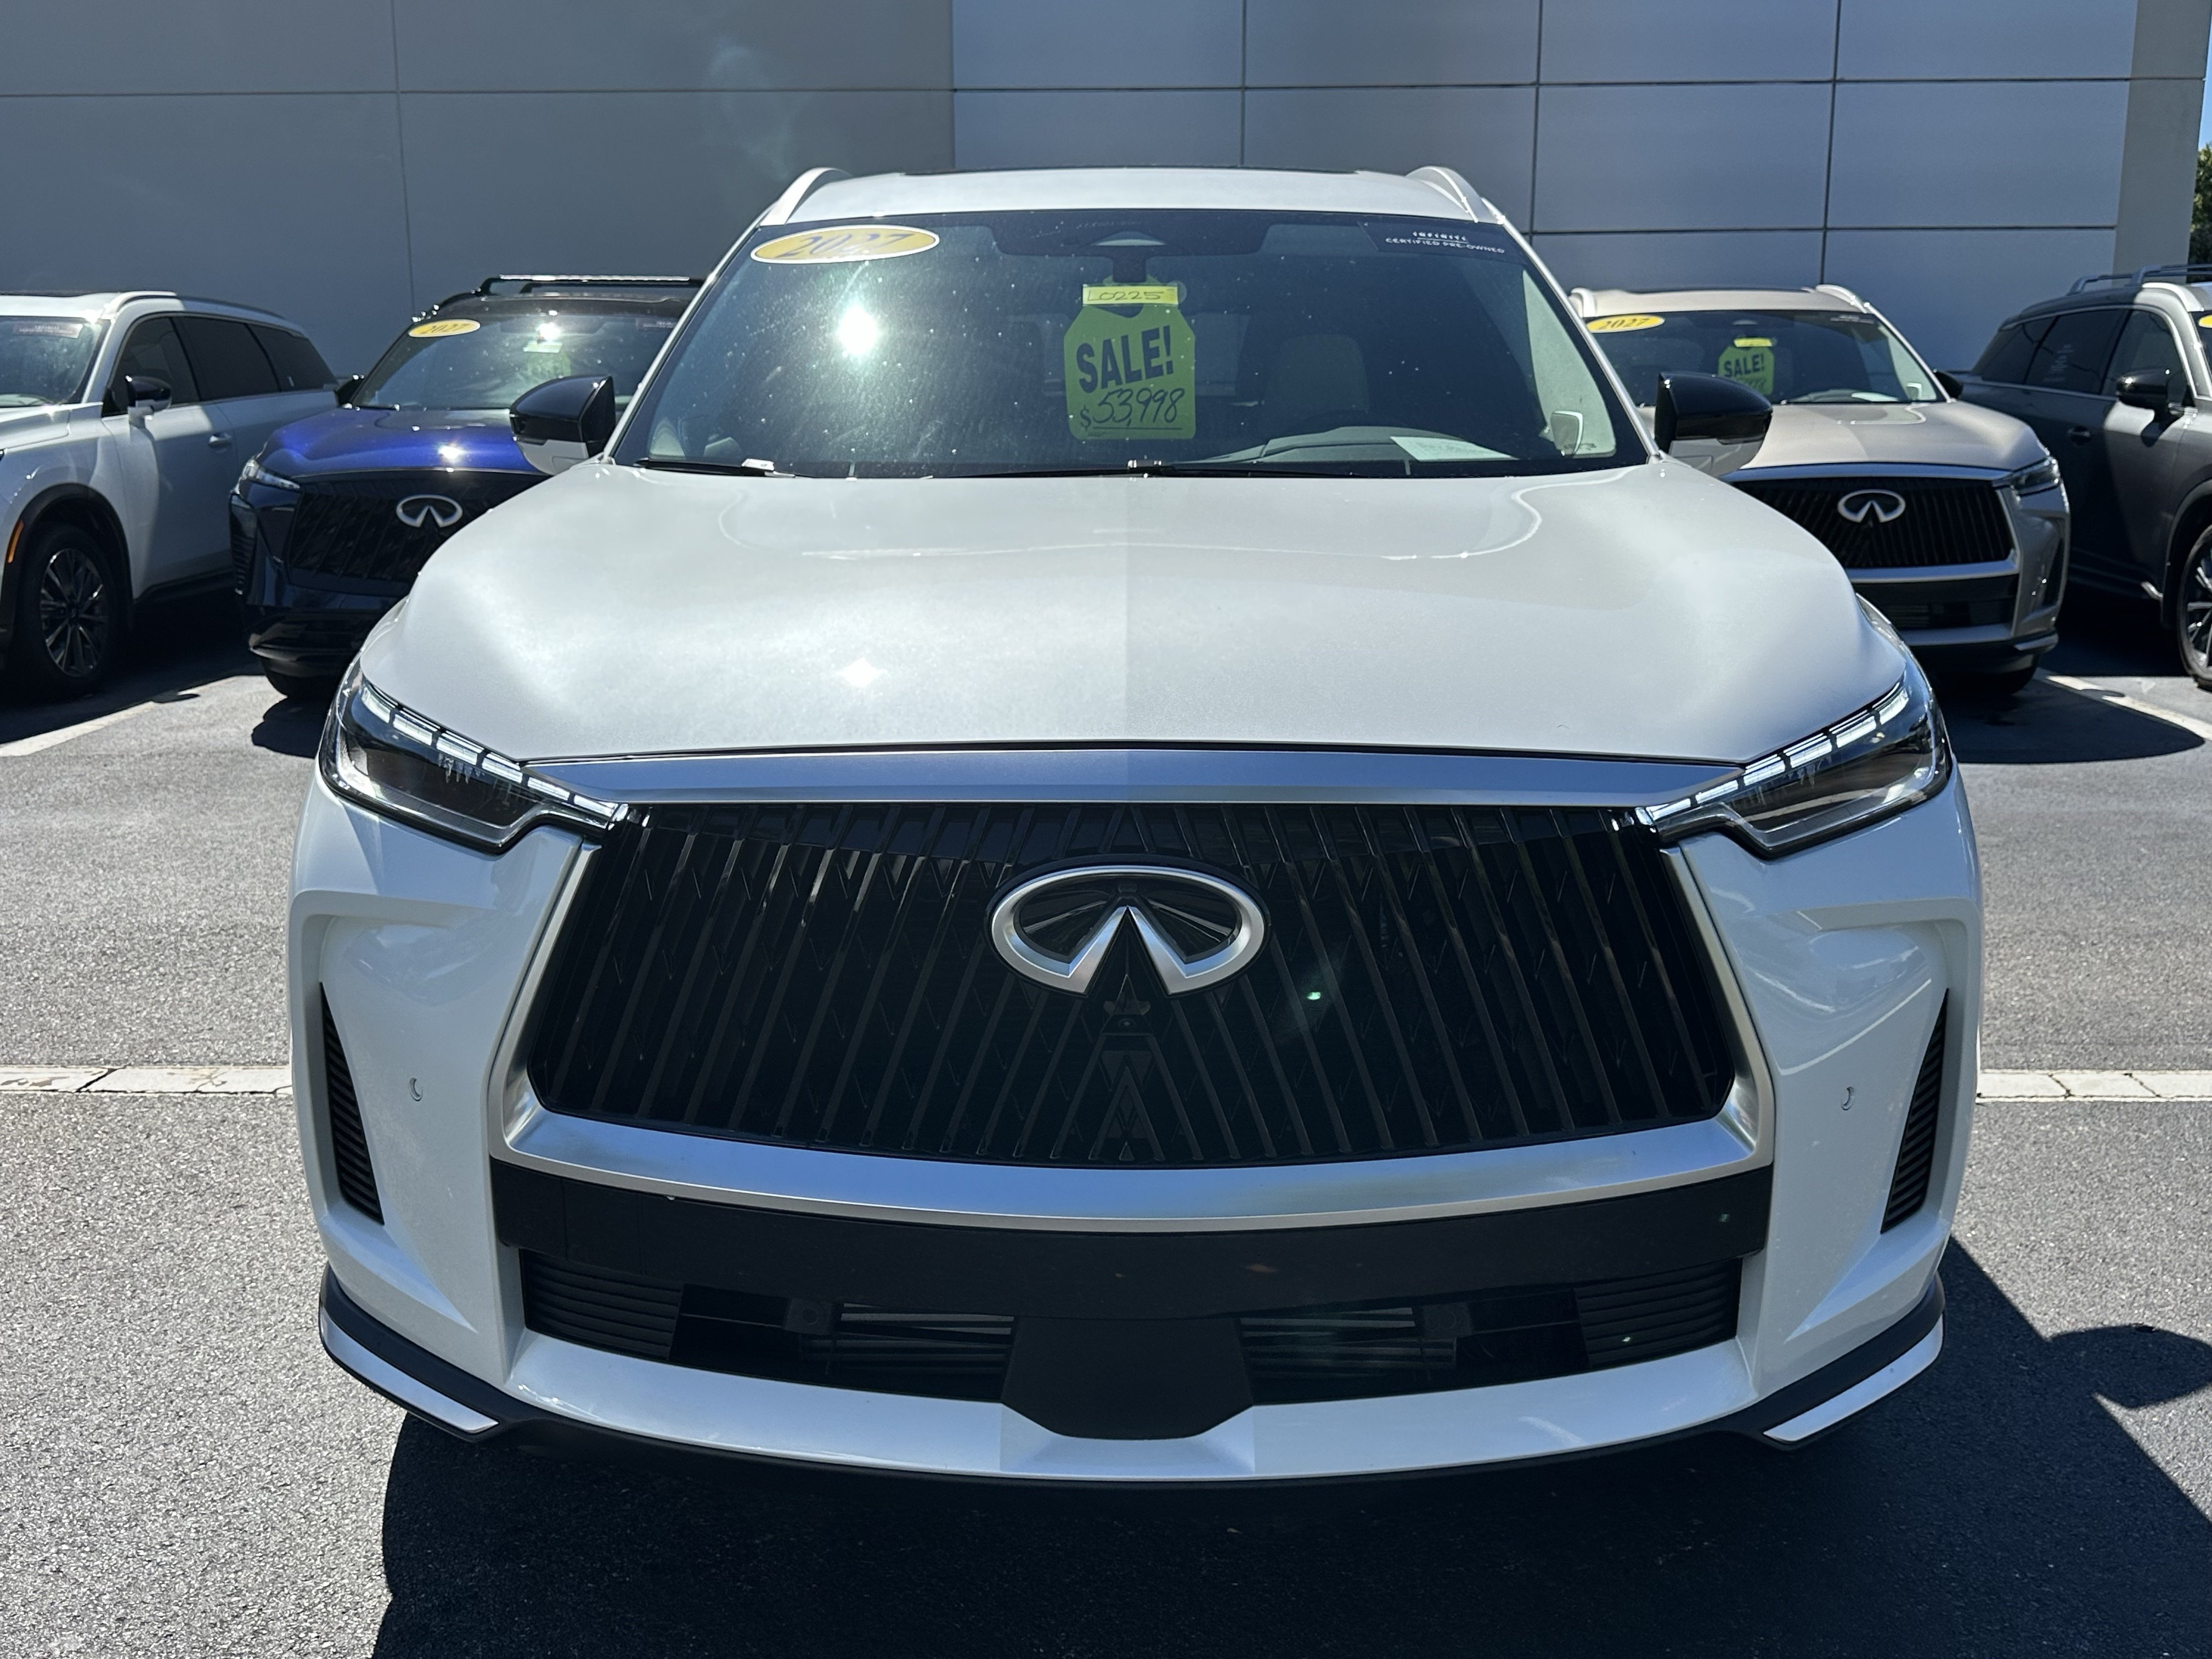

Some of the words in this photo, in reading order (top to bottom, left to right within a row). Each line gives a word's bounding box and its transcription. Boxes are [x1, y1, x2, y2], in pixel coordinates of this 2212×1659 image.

[1385, 237, 1440, 246] CERTIFIED
[1598, 318, 1650, 330] 2027
[1076, 325, 1174, 393] SALE!
[1724, 353, 1765, 377] SALE!
